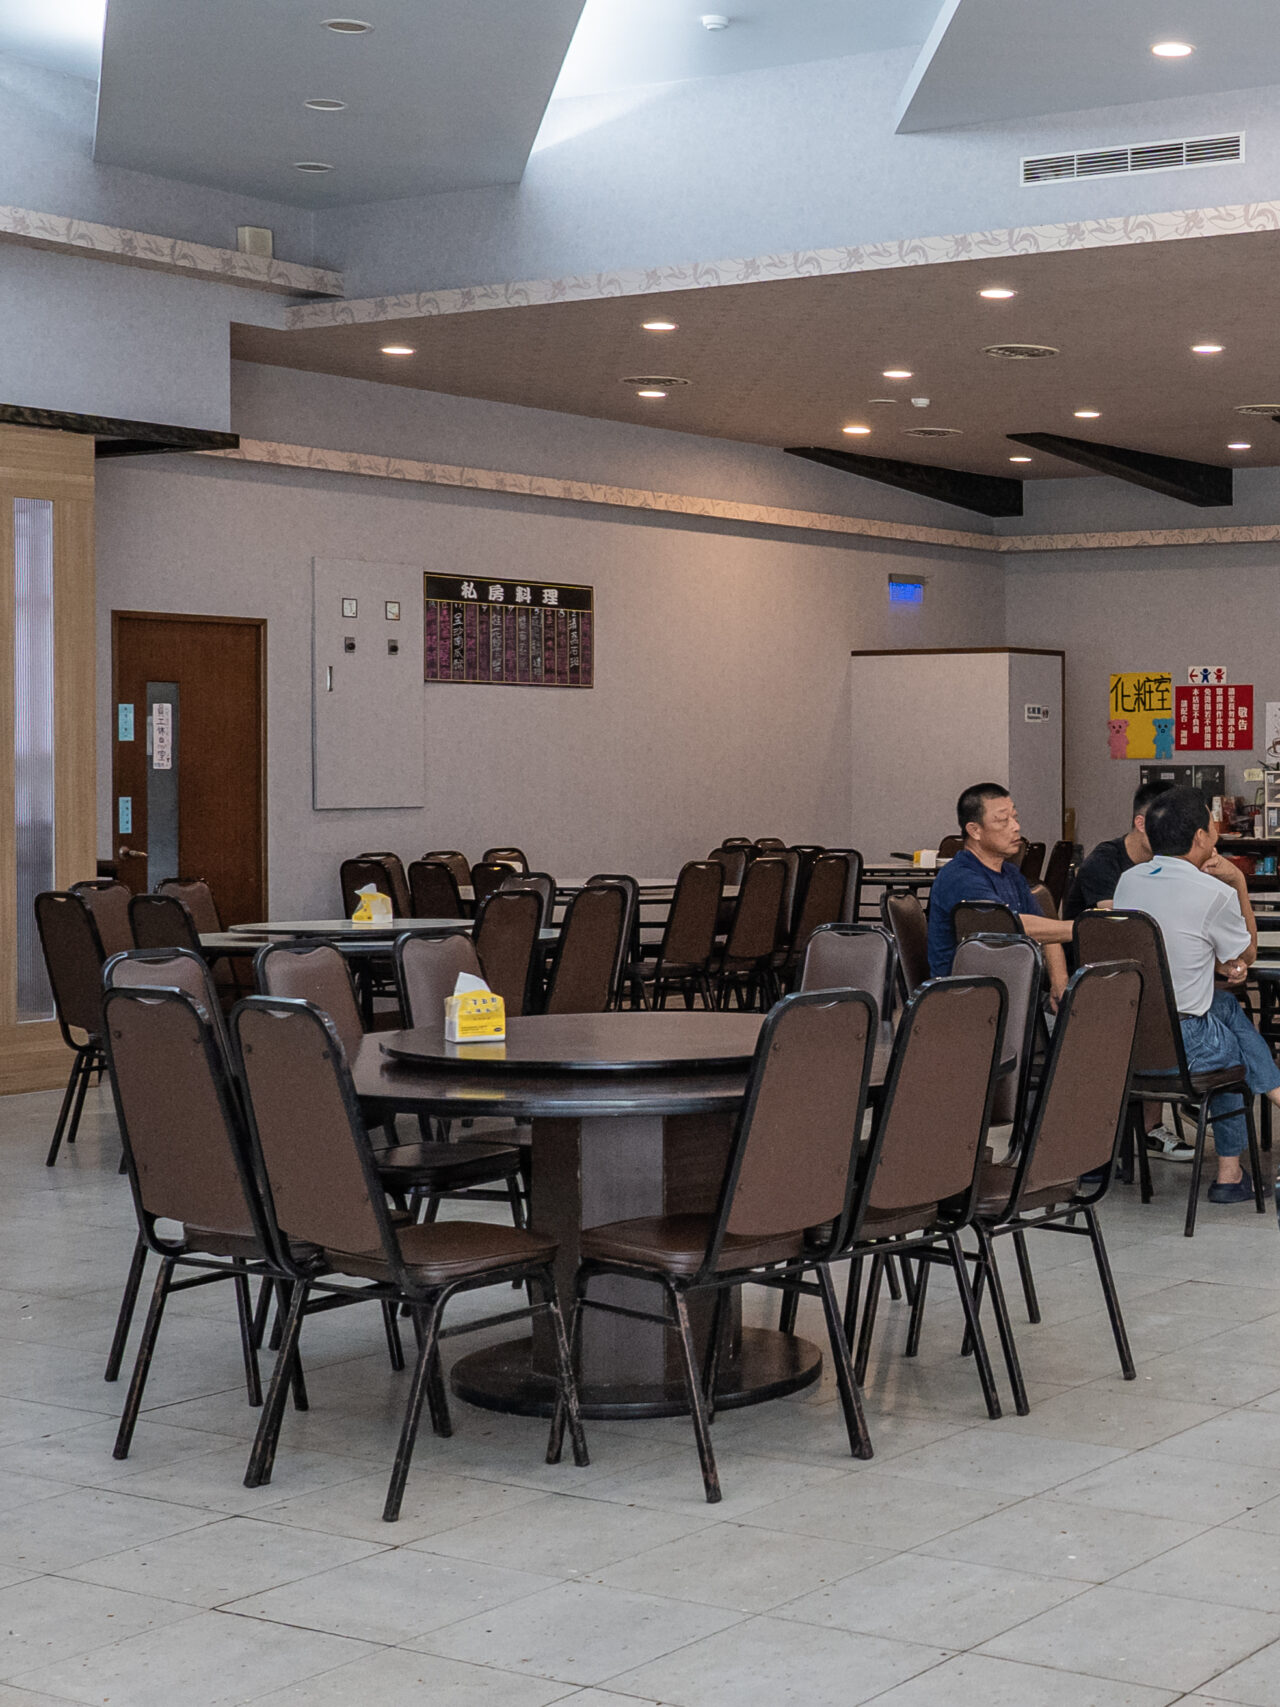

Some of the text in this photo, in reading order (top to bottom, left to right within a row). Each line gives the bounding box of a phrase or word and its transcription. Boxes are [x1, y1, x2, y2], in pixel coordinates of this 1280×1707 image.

[460, 581, 559, 606] 私房料理
[1110, 675, 1172, 712] 化粧室
[1238, 706, 1248, 731] 敬告
